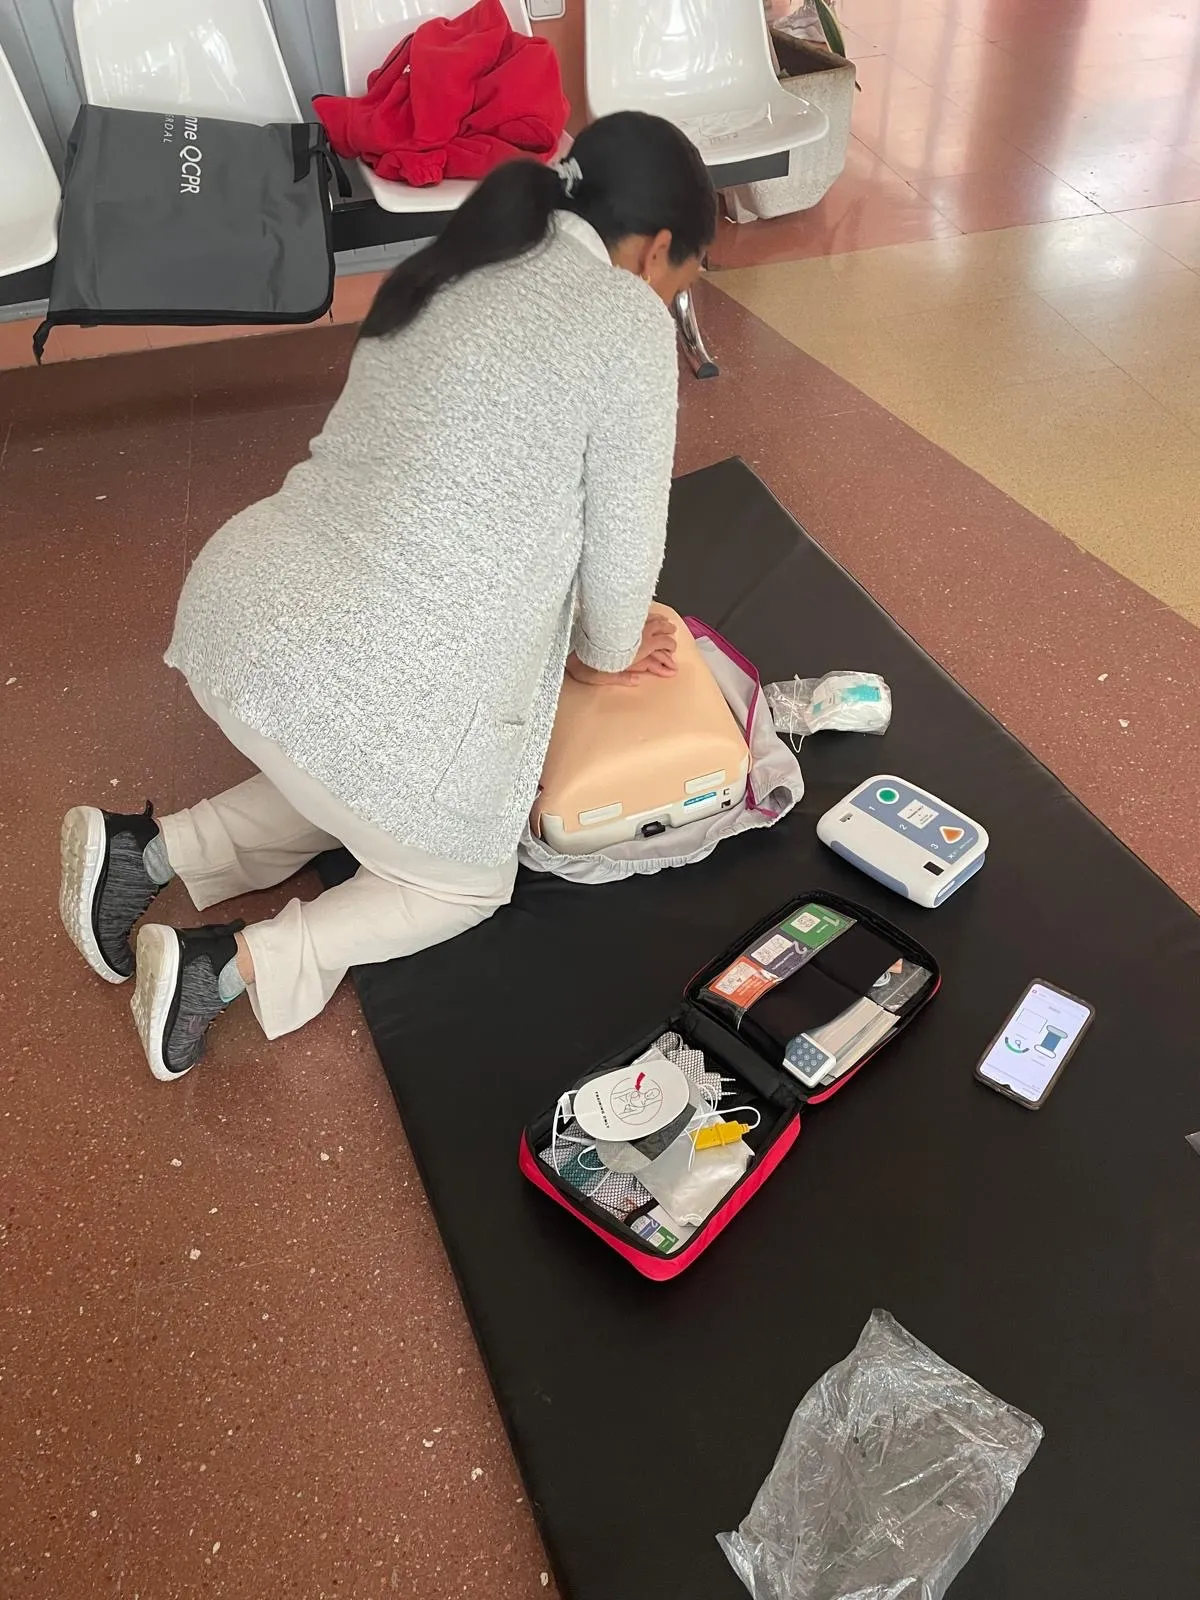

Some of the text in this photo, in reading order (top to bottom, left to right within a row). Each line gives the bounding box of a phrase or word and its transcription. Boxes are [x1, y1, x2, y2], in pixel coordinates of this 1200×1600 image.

[180, 145, 202, 194] QCPR
[822, 915, 840, 927] 1
[793, 940, 808, 955] 2
